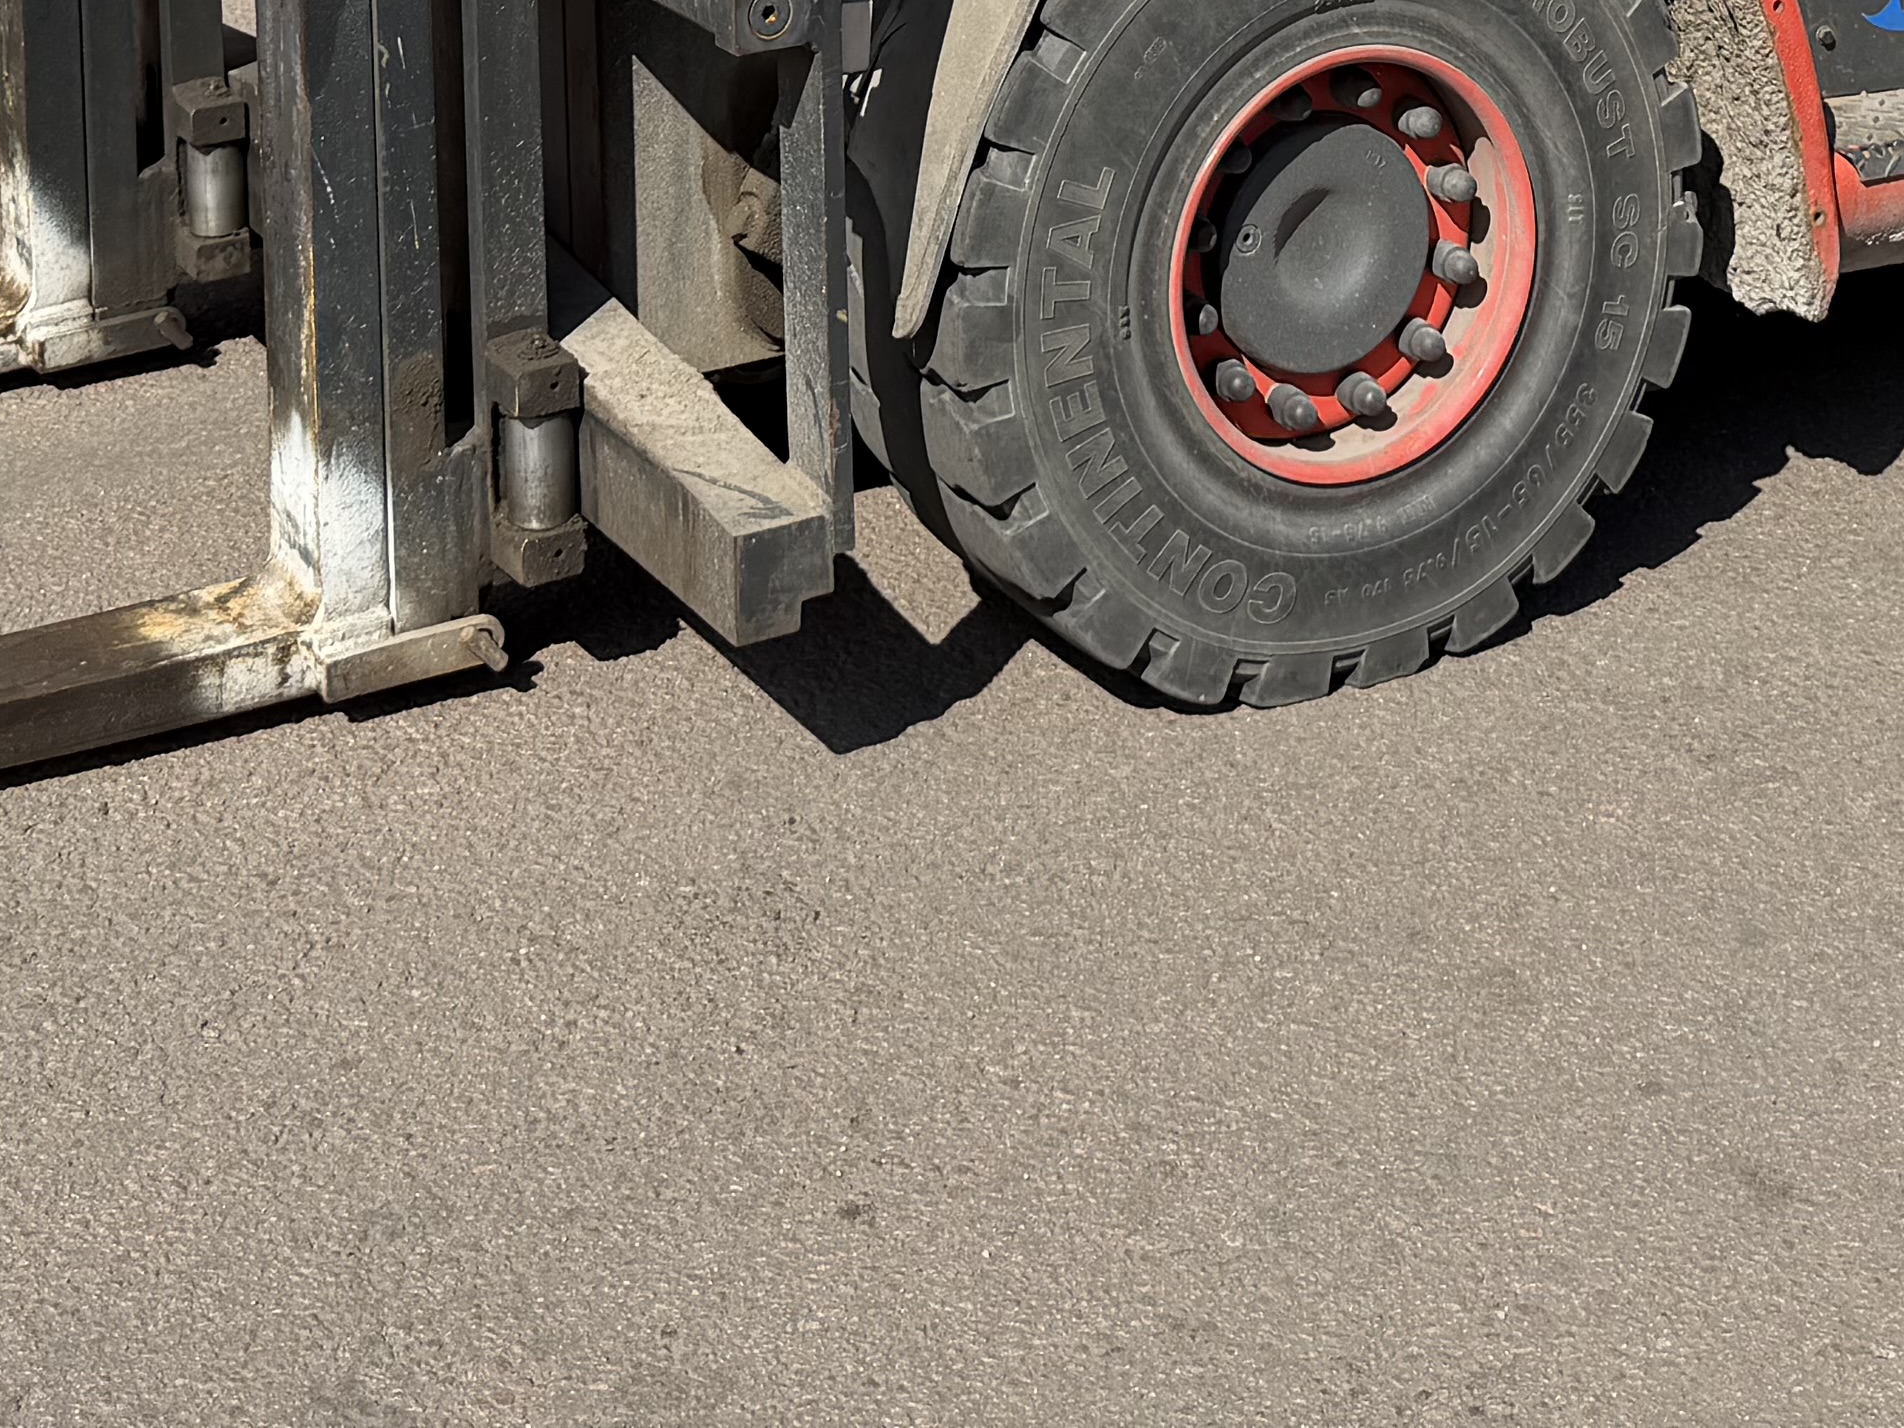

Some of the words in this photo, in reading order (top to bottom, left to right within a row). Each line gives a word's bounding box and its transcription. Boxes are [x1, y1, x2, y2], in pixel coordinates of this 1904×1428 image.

[1609, 193, 1641, 270] SC
[1595, 294, 1630, 352] 15
[1039, 166, 1297, 625] CONTINENTAL
